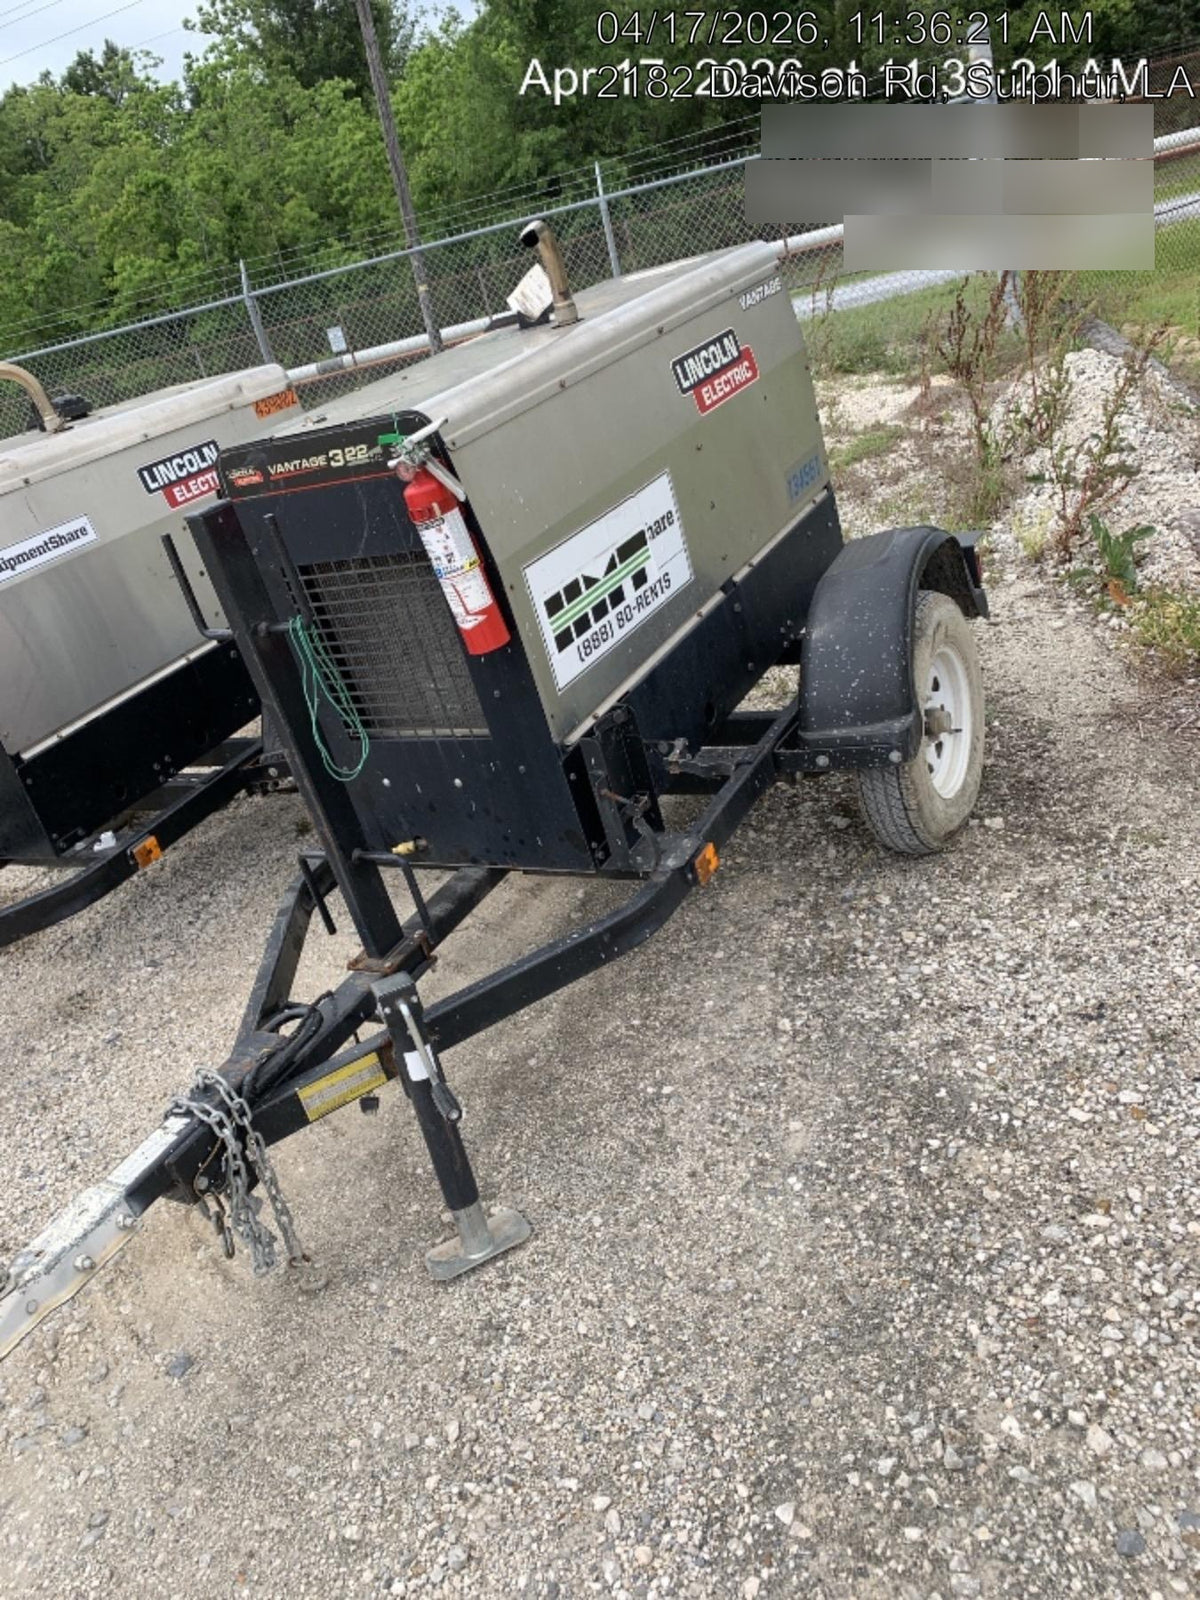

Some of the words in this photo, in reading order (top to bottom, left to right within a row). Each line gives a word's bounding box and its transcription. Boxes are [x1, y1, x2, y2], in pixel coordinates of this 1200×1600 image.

[675, 334, 739, 389] LINCOLN
[701, 360, 753, 406] ELECTRIC
[143, 444, 218, 490] LINCOLN
[268, 454, 328, 476] VANTAGE
[328, 444, 369, 467] 322
[576, 620, 615, 662] (888)
